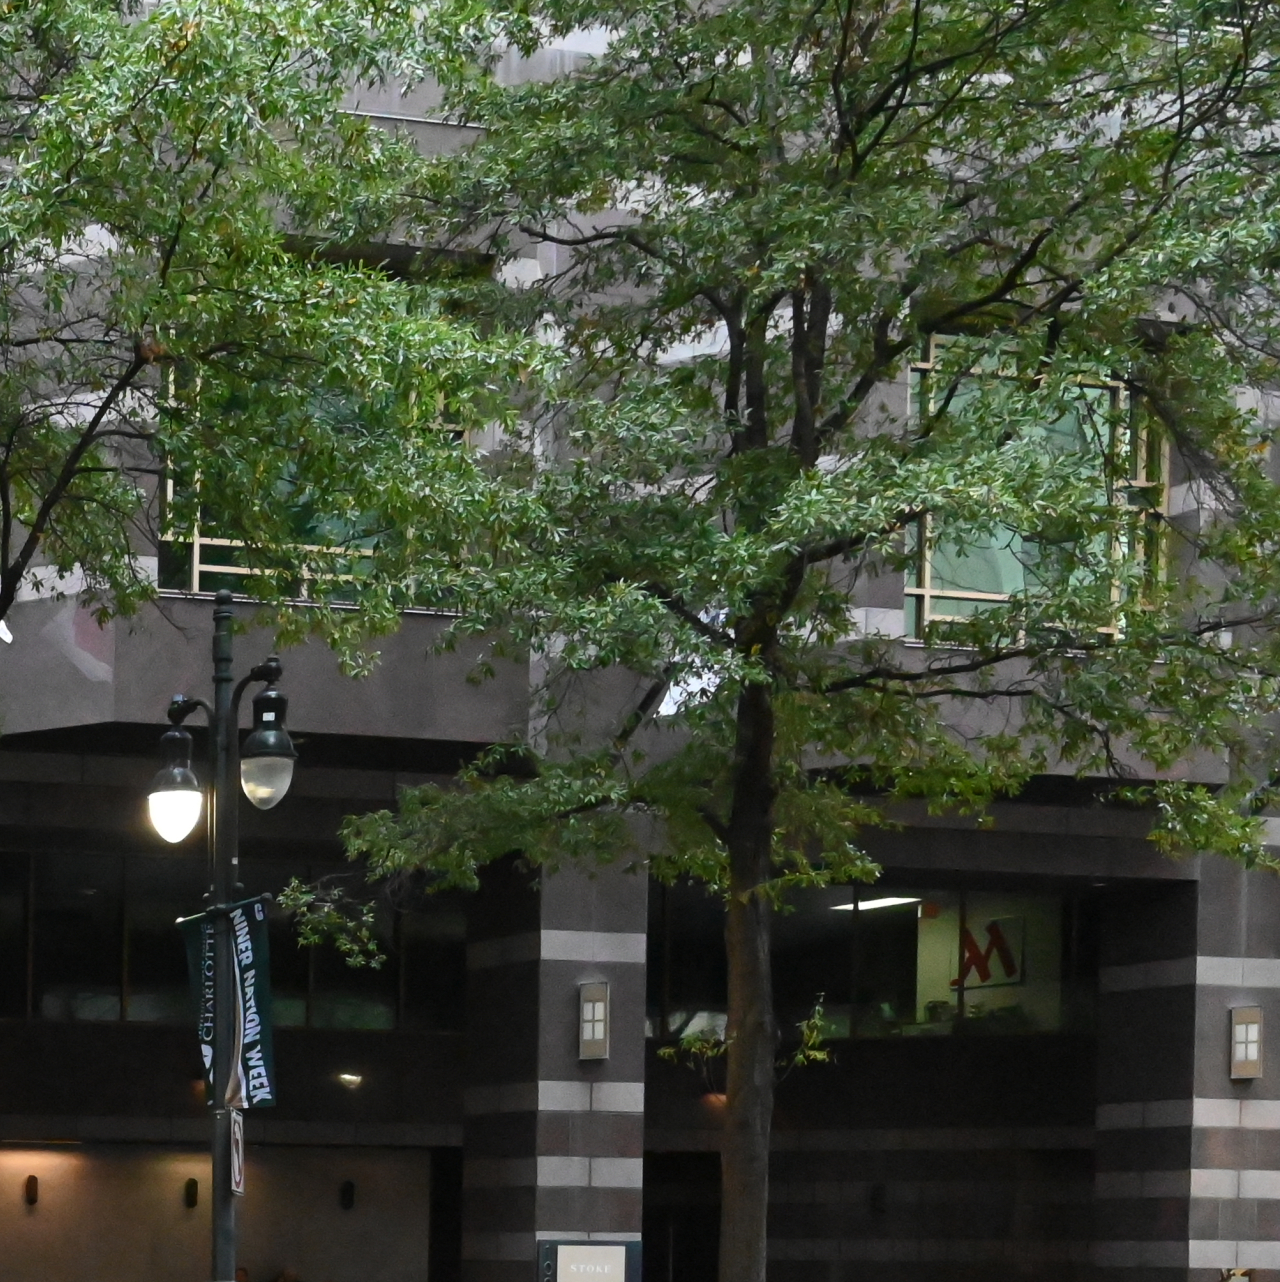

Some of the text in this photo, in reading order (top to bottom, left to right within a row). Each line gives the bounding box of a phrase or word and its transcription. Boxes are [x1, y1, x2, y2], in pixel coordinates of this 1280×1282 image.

[230, 908, 272, 1104] NINER NATION WEEK
[570, 1264, 611, 1273] STOKE
